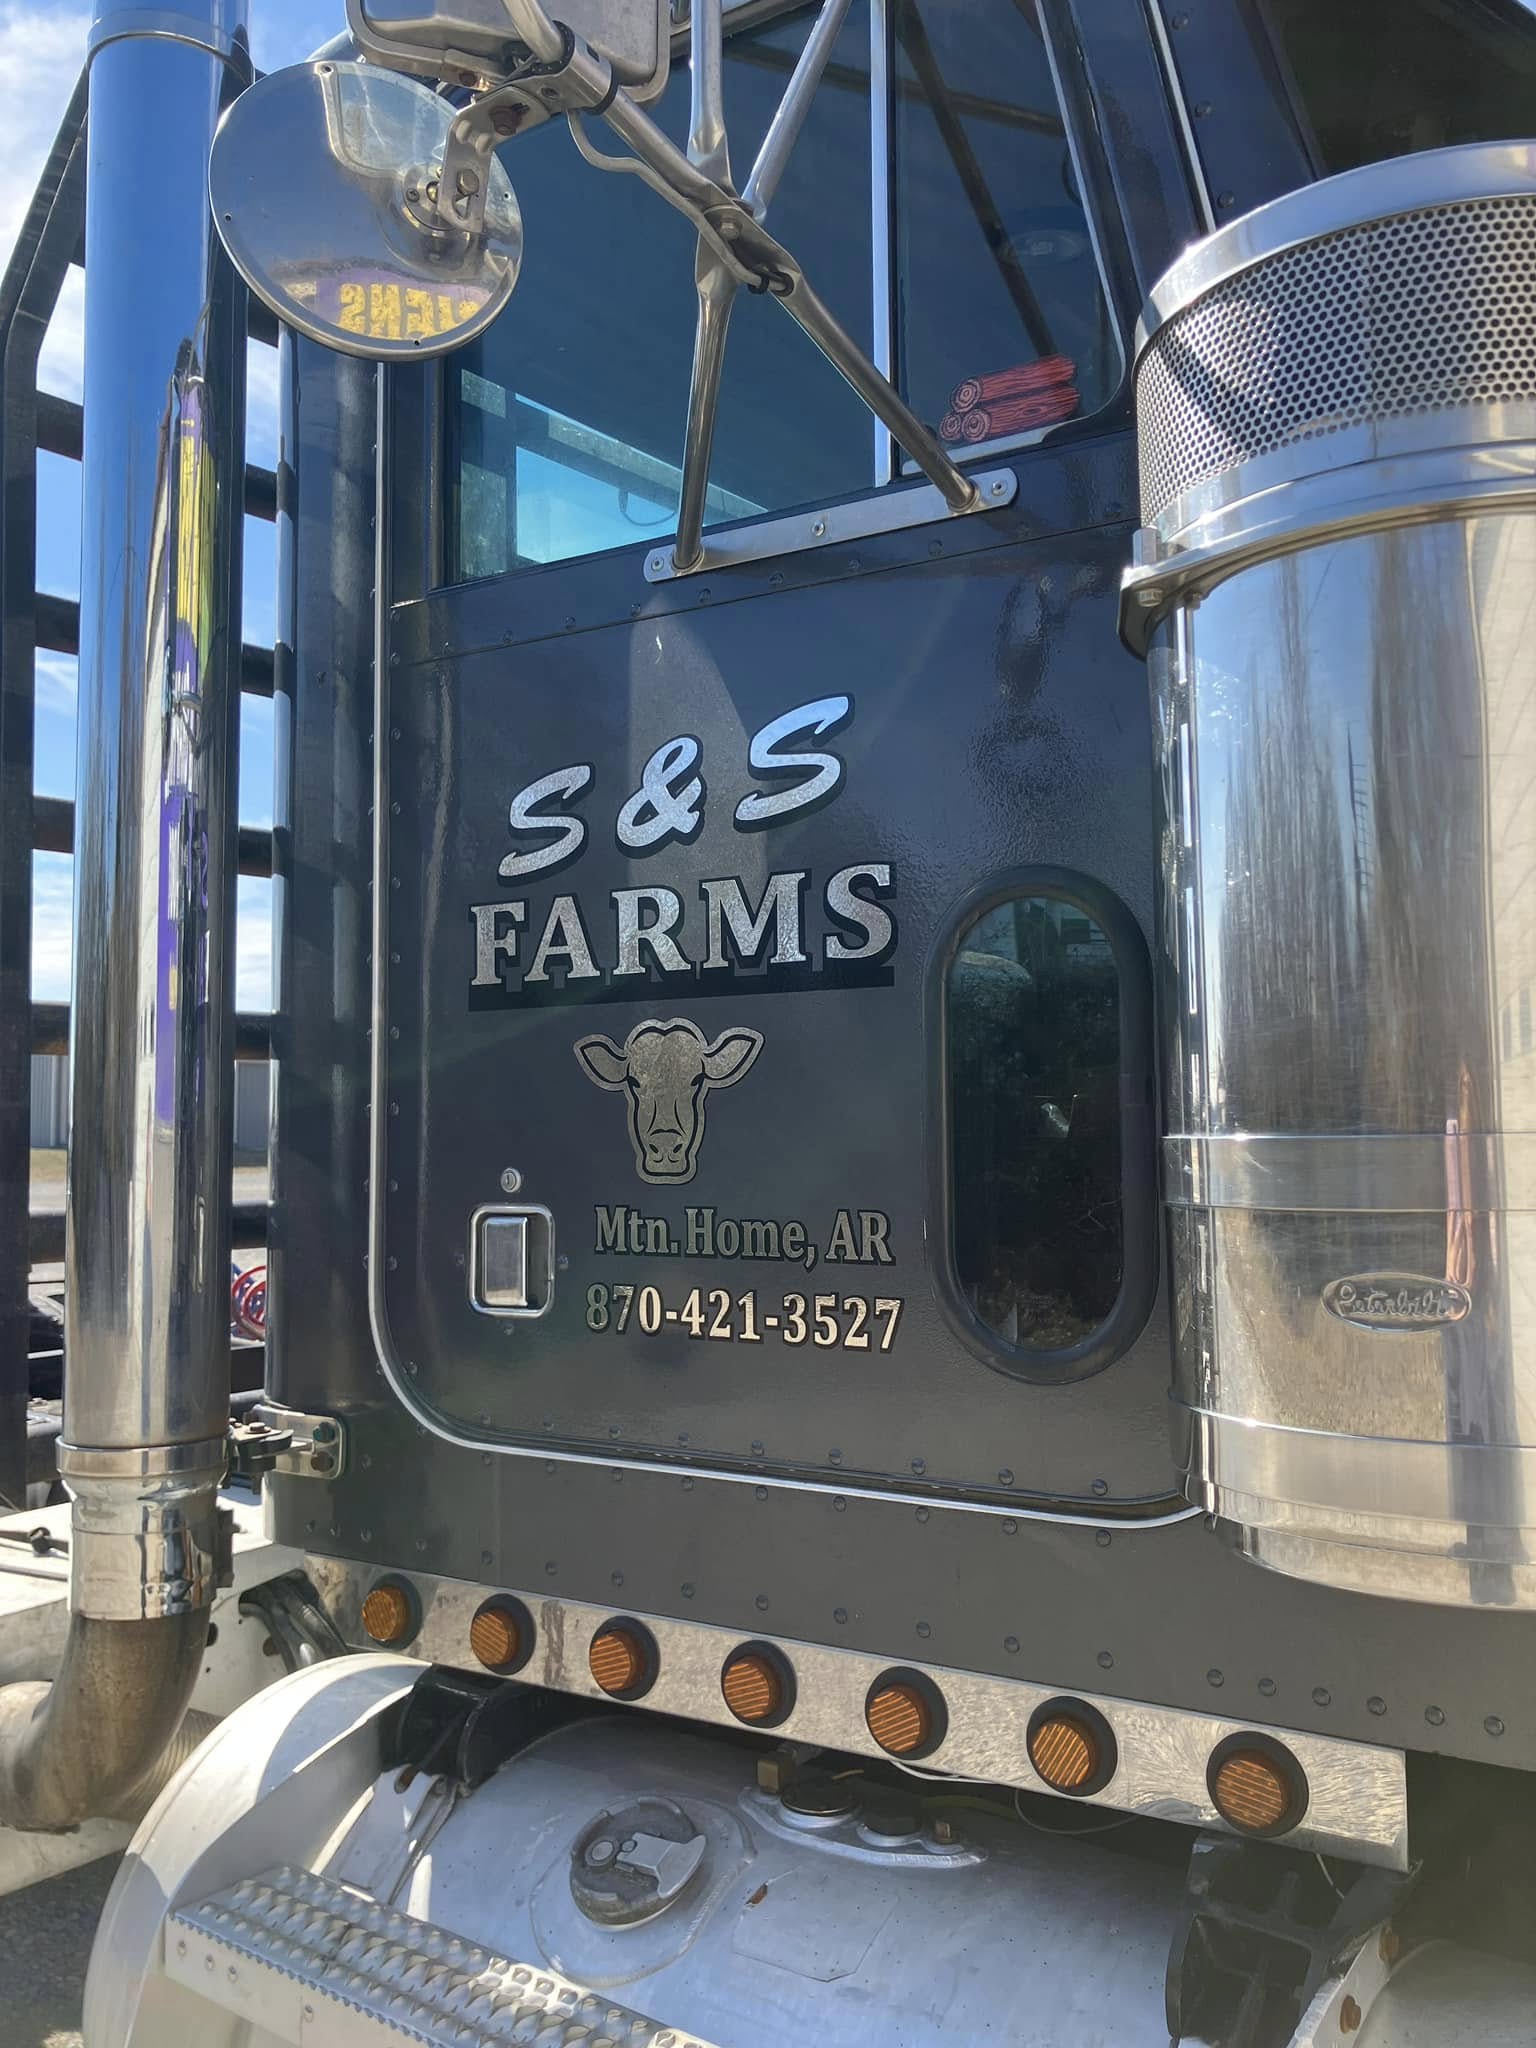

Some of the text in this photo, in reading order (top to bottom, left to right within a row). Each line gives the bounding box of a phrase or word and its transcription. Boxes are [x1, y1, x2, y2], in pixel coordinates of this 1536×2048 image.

[497, 695, 850, 877] S & S
[470, 863, 893, 986] FARMS
[594, 1205, 893, 1269] Mtn. Home, AR
[585, 1283, 902, 1350] 870-421-3527
